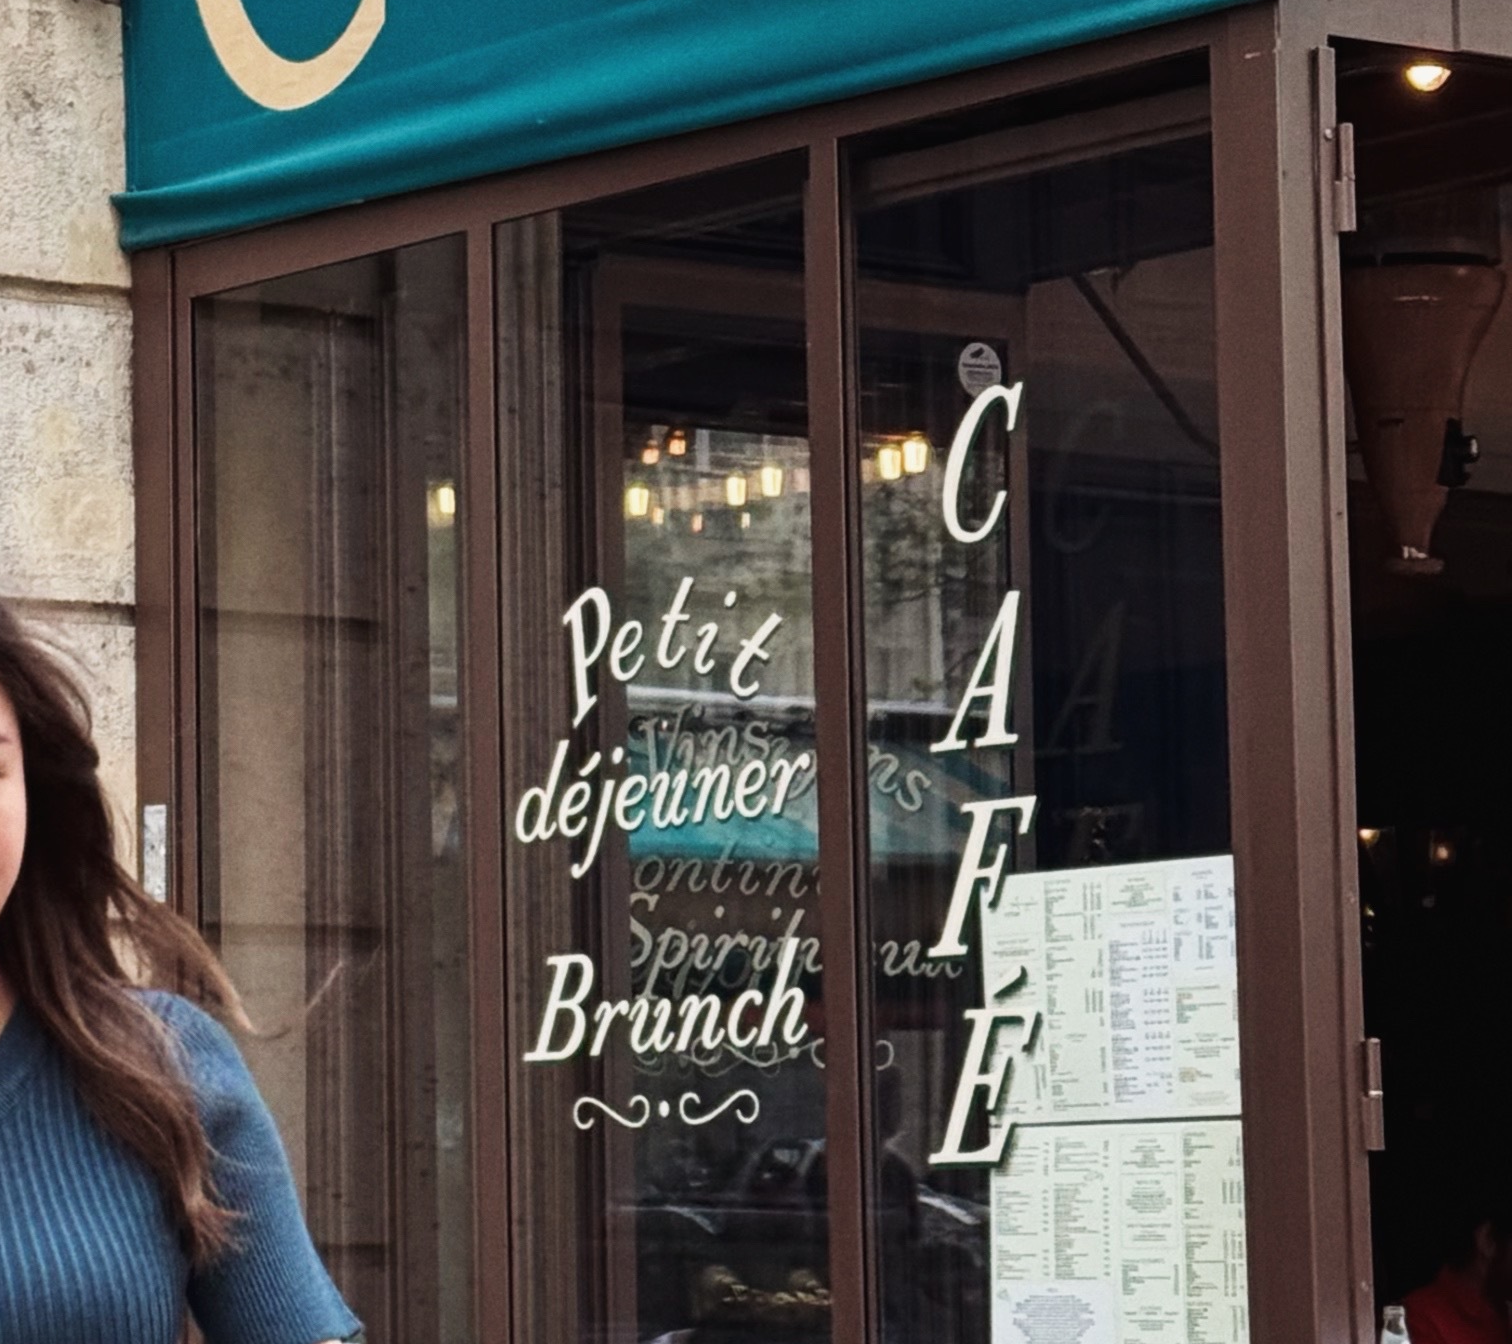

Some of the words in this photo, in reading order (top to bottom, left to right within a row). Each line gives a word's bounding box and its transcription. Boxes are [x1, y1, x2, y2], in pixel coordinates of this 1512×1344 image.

[562, 576, 784, 728] Petit
[514, 738, 812, 879] déjeuner
[928, 381, 1042, 1165] CAFÉ
[523, 937, 809, 1063] Brunch
